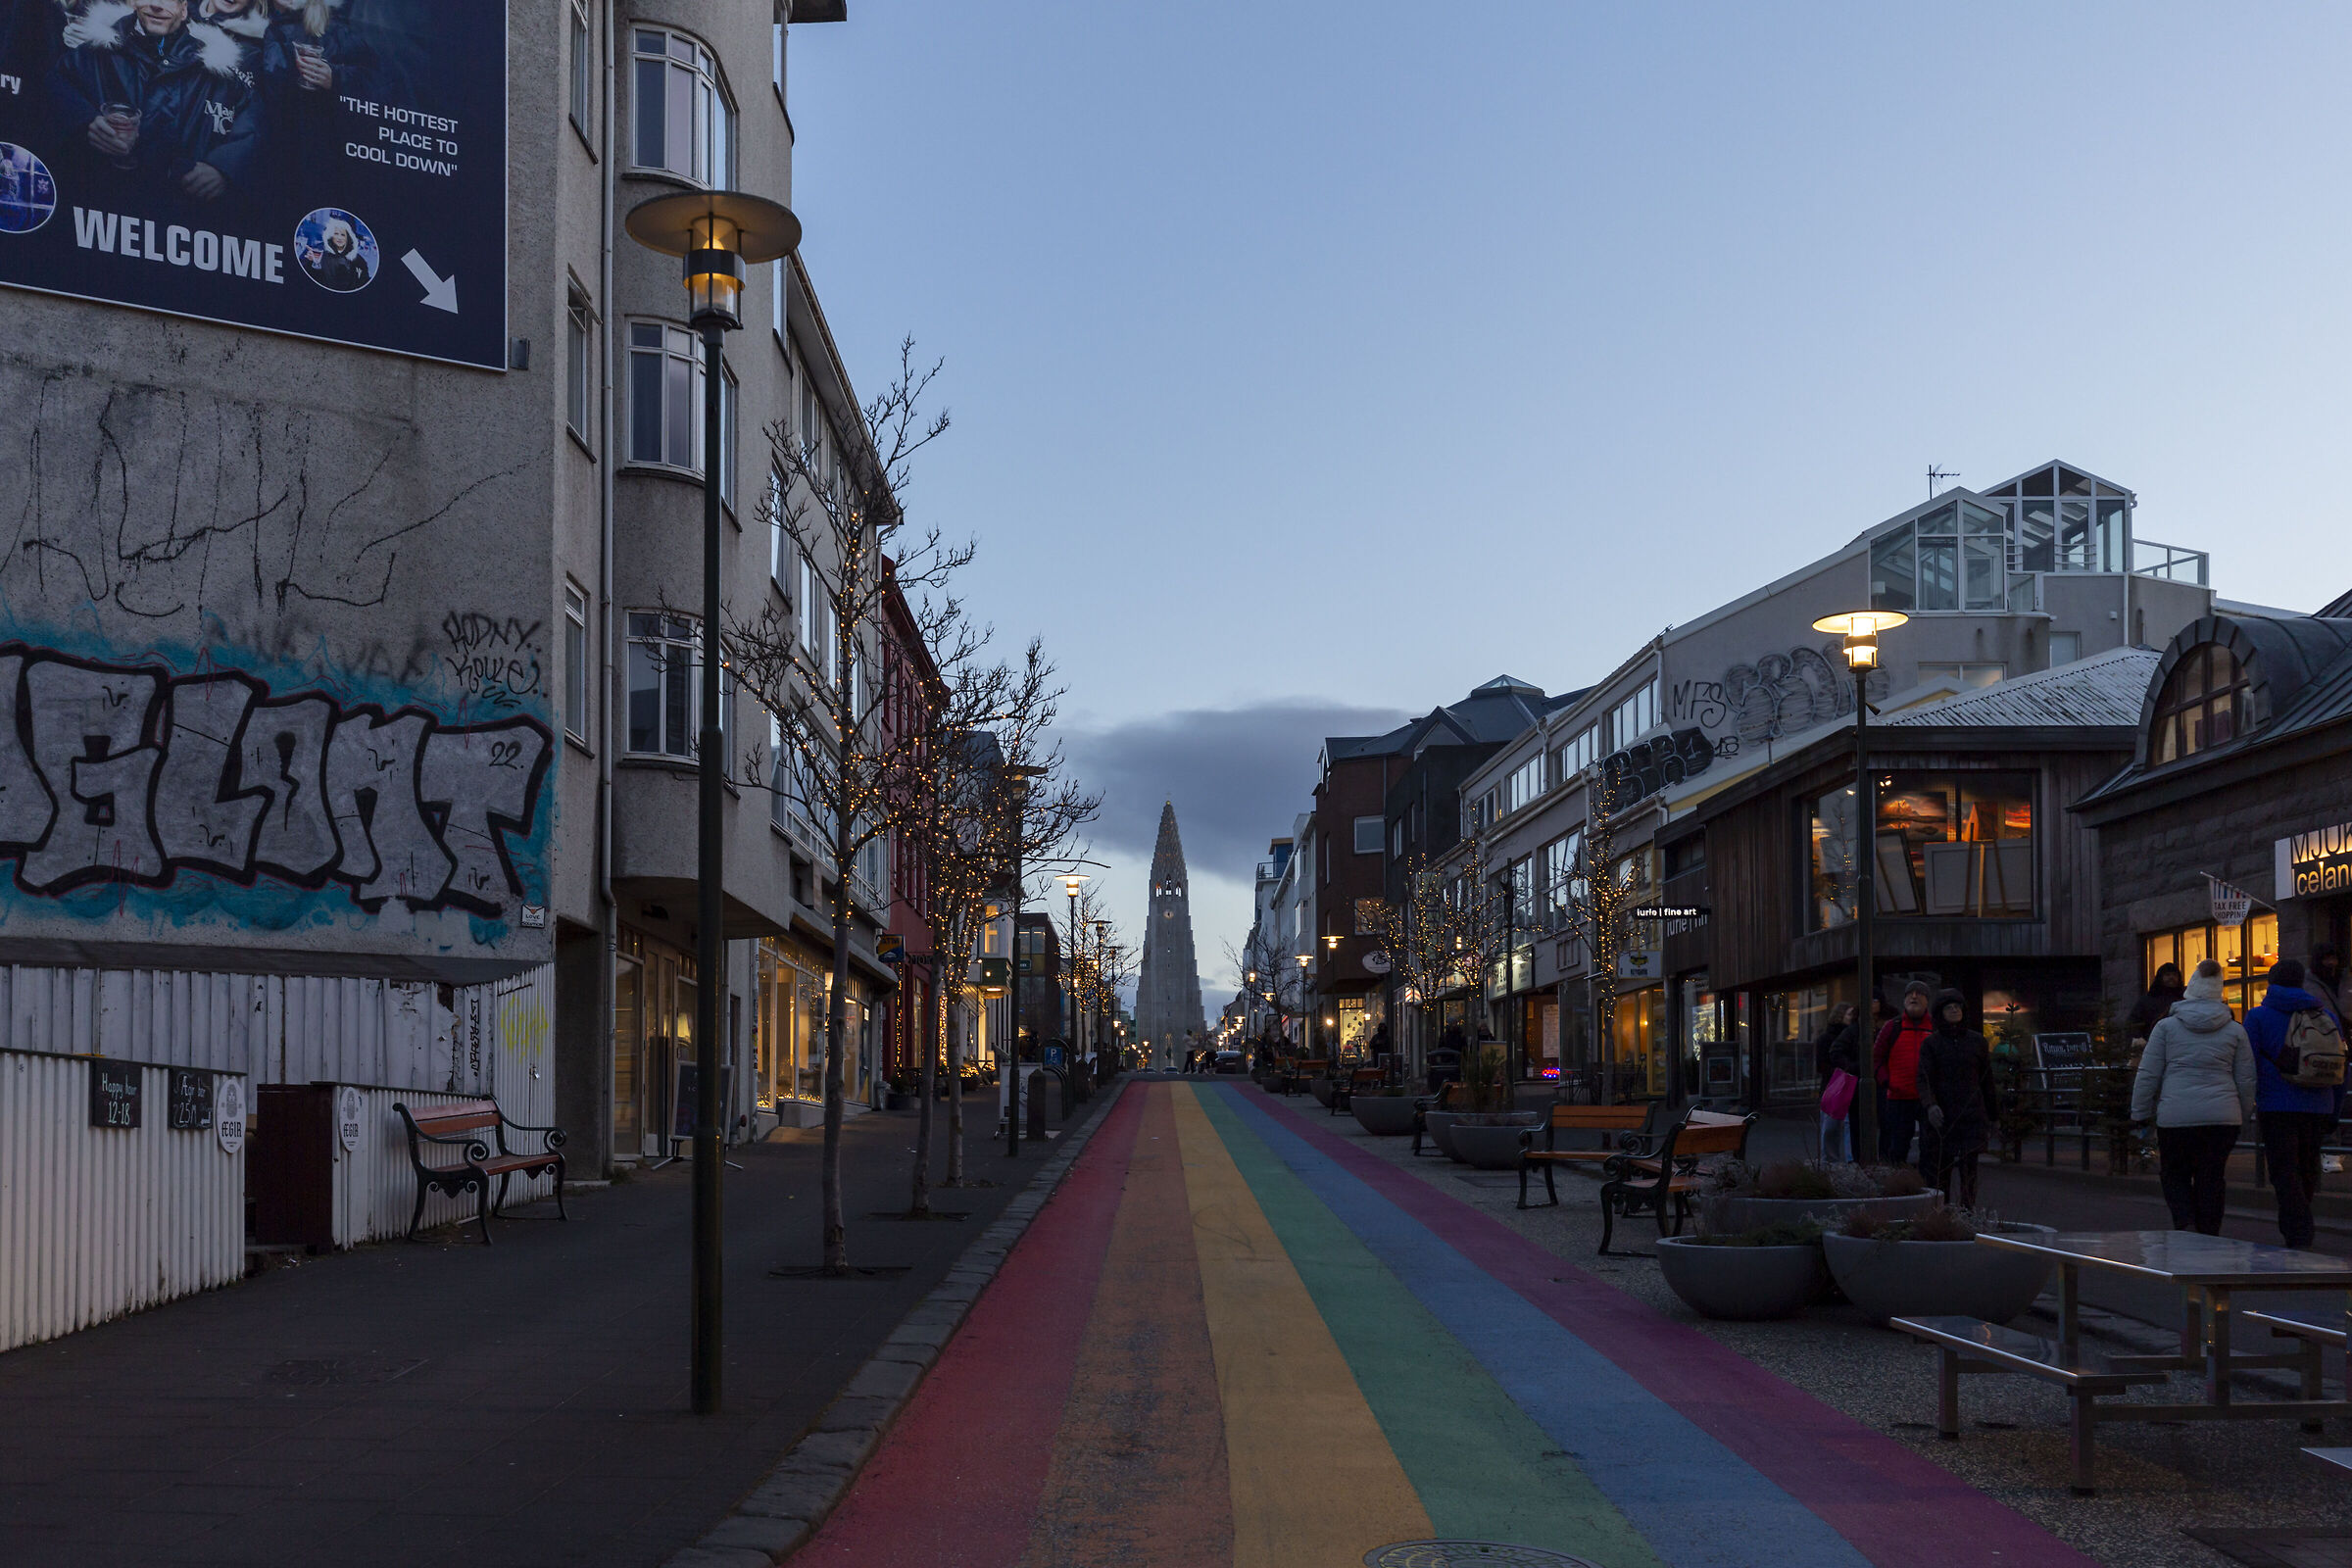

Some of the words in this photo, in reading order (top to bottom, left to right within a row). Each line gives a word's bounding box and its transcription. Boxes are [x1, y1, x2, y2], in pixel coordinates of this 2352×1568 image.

[339, 95, 379, 118] "THE
[383, 105, 459, 133] HOTTEST
[378, 126, 432, 151] PLACE
[436, 138, 459, 156] TO
[345, 142, 391, 165] COOL
[395, 152, 458, 176] DOWN"
[73, 206, 284, 284] WELCOME
[1684, 907, 1697, 916] art
[2214, 902, 2227, 910] TAX
[2229, 901, 2247, 910] FREE
[1051, 1048, 1057, 1058] P
[102, 1072, 124, 1101] Happy
[108, 1101, 130, 1126] 12-18
